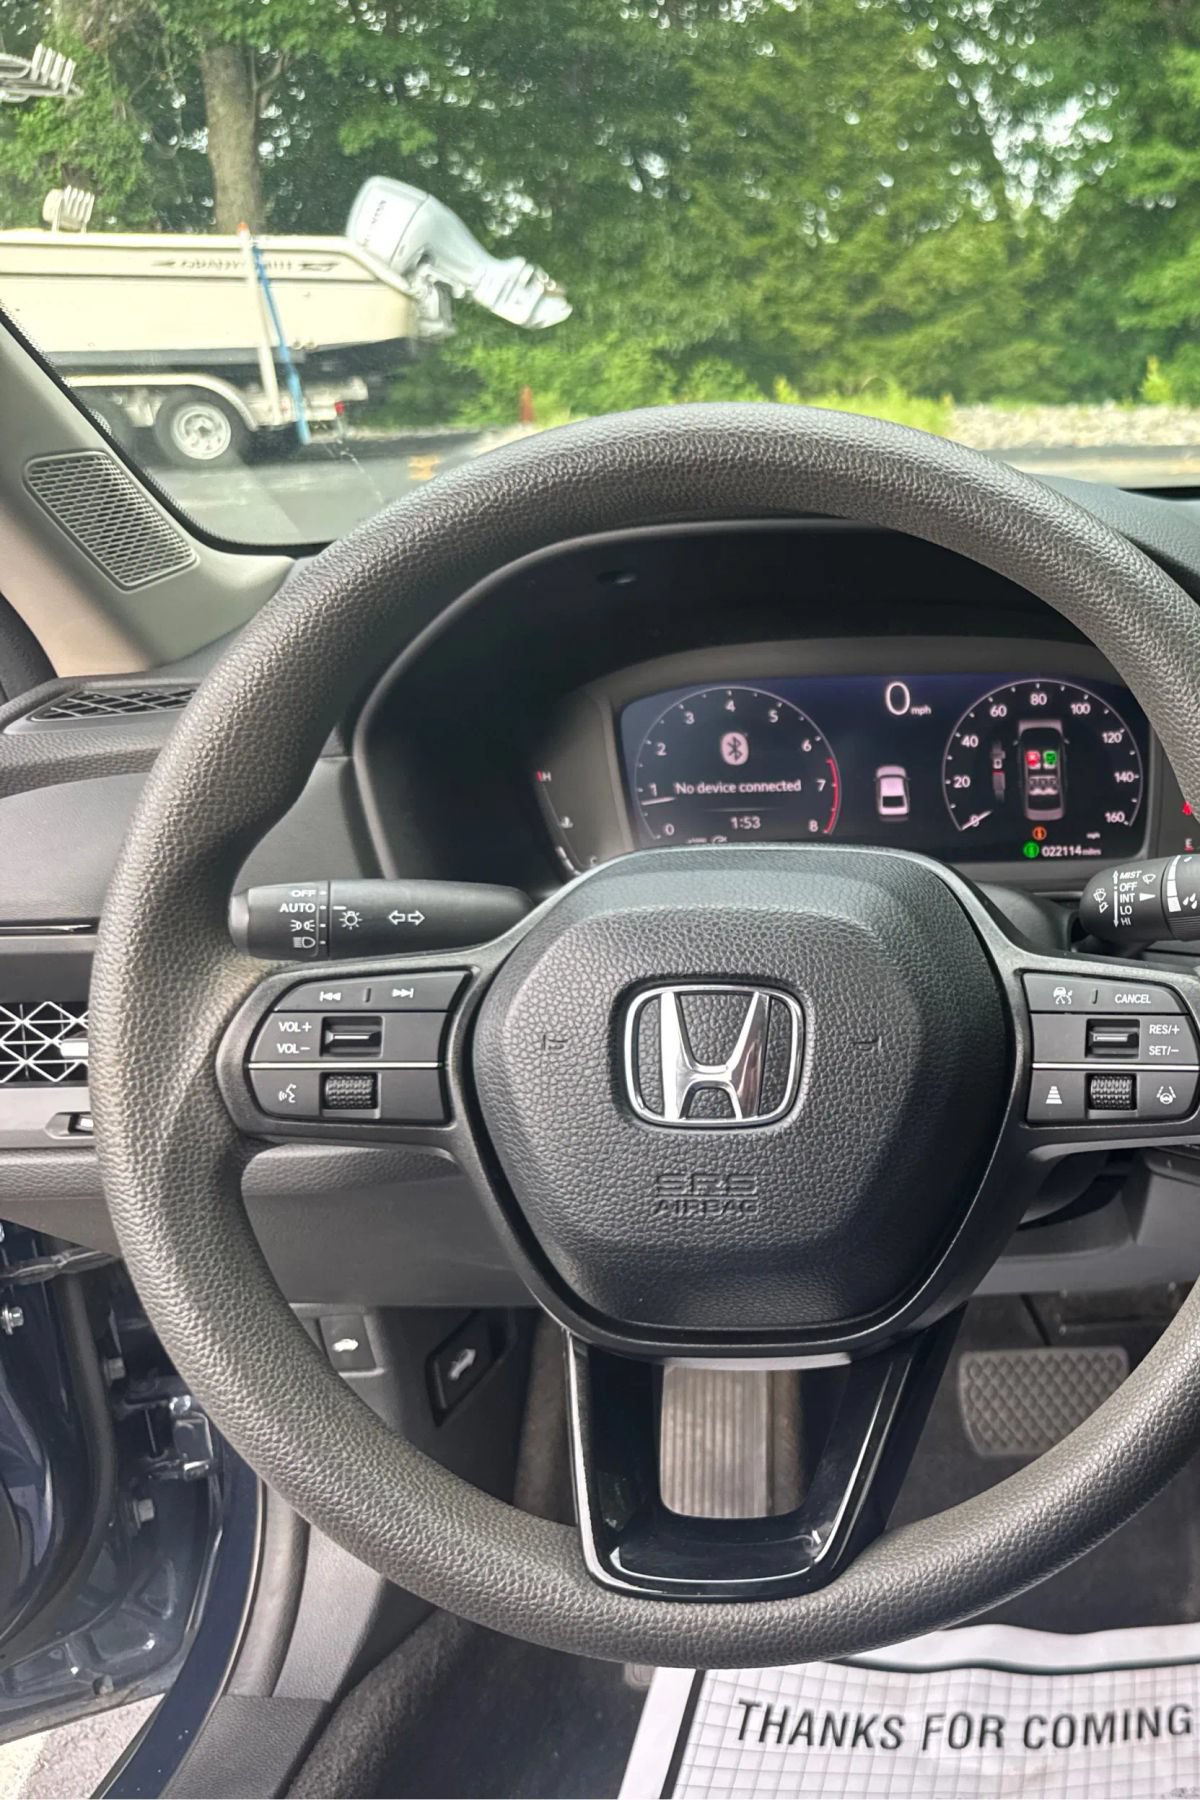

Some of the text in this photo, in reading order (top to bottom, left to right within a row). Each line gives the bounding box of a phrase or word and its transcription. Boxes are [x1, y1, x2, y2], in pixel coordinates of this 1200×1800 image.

[885, 682, 932, 716] 0 mph
[1030, 693, 1047, 706] 80
[725, 699, 736, 712] 4
[990, 705, 1007, 717] 60
[1070, 703, 1091, 715] 100
[685, 711, 695, 725] 3
[768, 710, 779, 723] 5
[961, 735, 979, 748] 40
[1102, 732, 1123, 744] 120
[656, 743, 667, 756] 2
[802, 739, 812, 752] 6
[954, 776, 971, 788] 20
[1114, 771, 1135, 783] 140
[650, 783, 657, 797] 1
[675, 780, 801, 794] No device connected
[816, 780, 826, 791] 7
[730, 816, 761, 830] 1:53
[1105, 811, 1125, 823] 160
[665, 823, 675, 836] 0
[808, 820, 819, 833] 8
[1041, 845, 1082, 857] 022114
[1119, 871, 1142, 880] MIST
[1119, 882, 1138, 892] OFF
[291, 889, 316, 898] OFF
[1119, 893, 1135, 903] INT
[279, 903, 316, 913] AUTO
[1120, 905, 1133, 915] LO
[1120, 917, 1131, 926] HI
[1115, 994, 1152, 1004] CANCEL
[656, 1173, 758, 1197] SRS
[654, 1200, 760, 1217] AIRBAG
[735, 1699, 903, 1752] THANKS
[921, 1710, 1005, 1752] FOR
[1022, 1703, 1192, 1751] COMING
